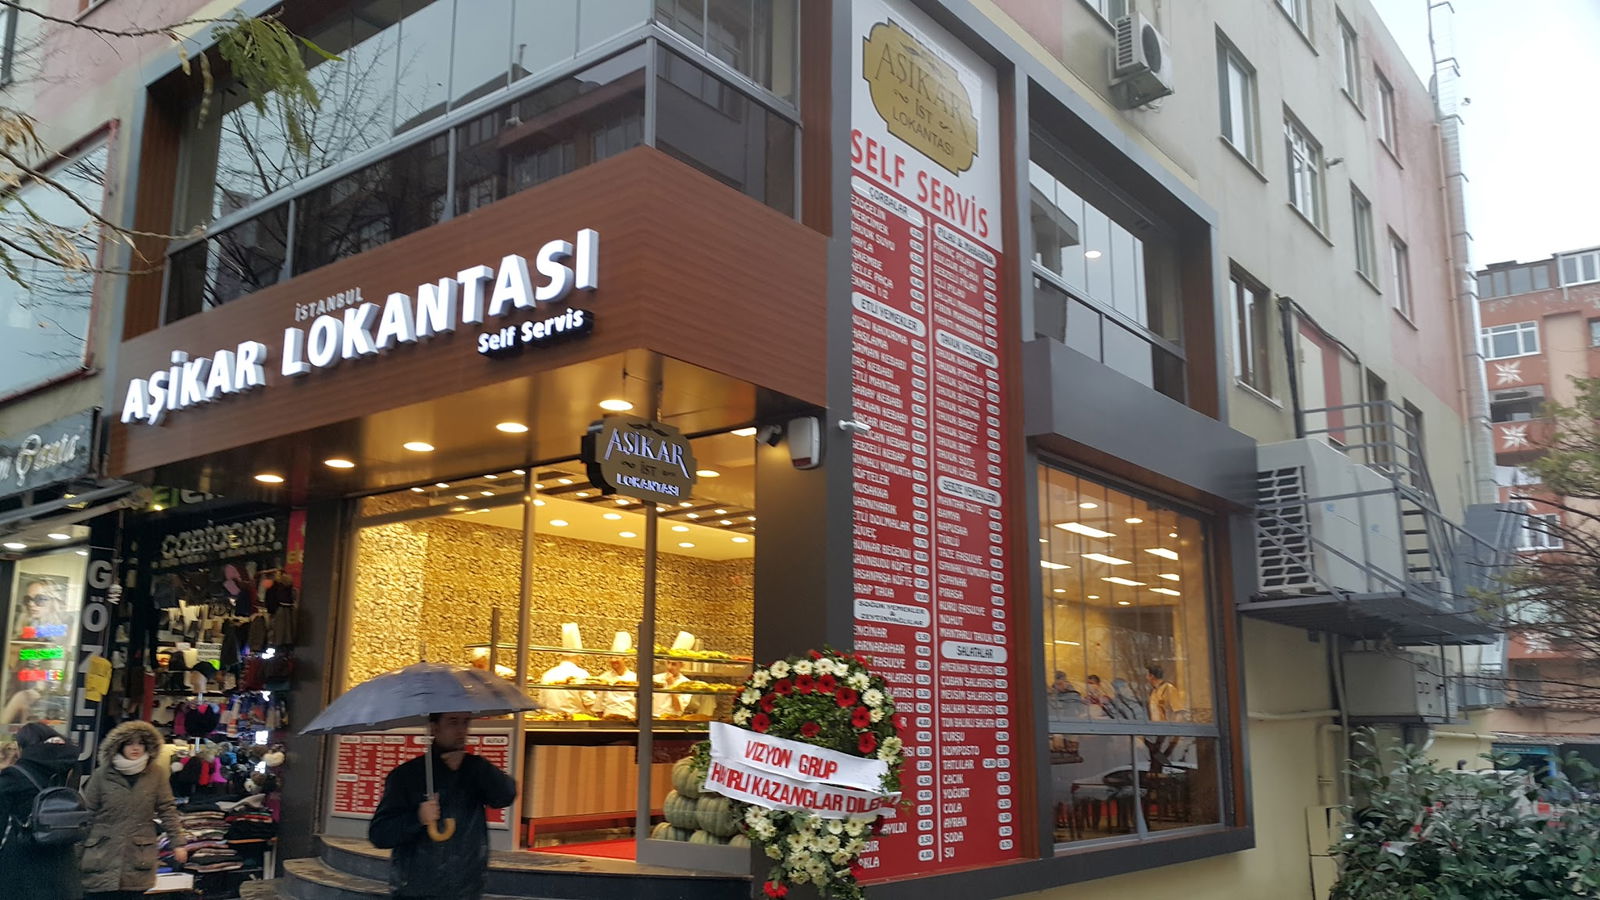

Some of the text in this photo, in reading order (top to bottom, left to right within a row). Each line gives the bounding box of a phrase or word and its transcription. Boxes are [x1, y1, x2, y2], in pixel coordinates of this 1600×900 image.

[850, 128, 988, 238] SELF SERVİS
[295, 287, 363, 322] İSTANBUL
[121, 228, 599, 426] AŞİKAR LOKANTASI
[478, 308, 584, 353] Self Servis
[616, 473, 680, 497] LOKANTASI
[72, 559, 113, 797] GÖZLÜ
[798, 754, 839, 780] GRUP
[882, 822, 907, 834] AYILDI
[944, 847, 954, 857] SU
